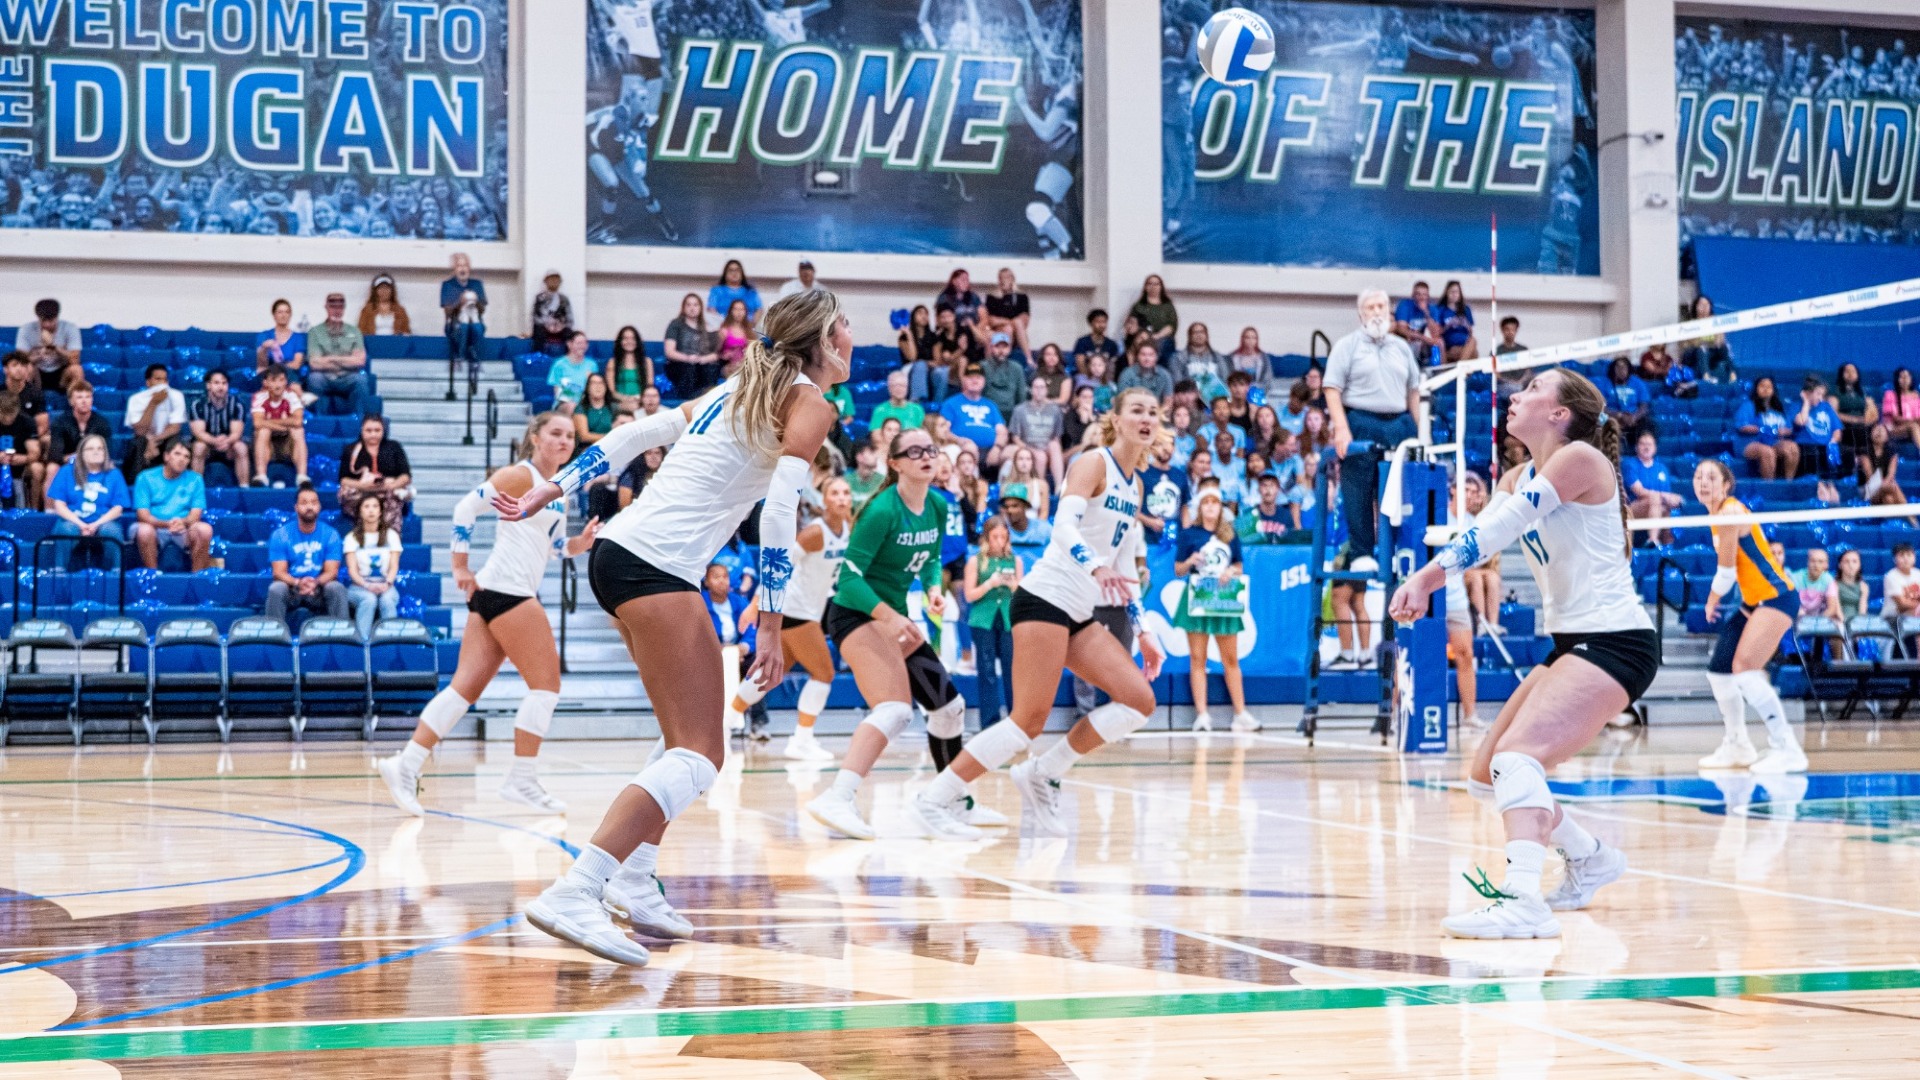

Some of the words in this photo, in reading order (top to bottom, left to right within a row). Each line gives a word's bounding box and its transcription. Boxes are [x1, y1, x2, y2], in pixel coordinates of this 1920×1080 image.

[0, 0, 369, 58] WELCOME
[396, 3, 486, 63] TO
[45, 58, 485, 178] DUGAN
[657, 39, 1023, 171] HOME
[1191, 69, 1331, 183] OF
[1354, 74, 1557, 193] THE
[689, 392, 732, 435] 11
[903, 550, 930, 573] 13
[1522, 529, 1549, 566] 17
